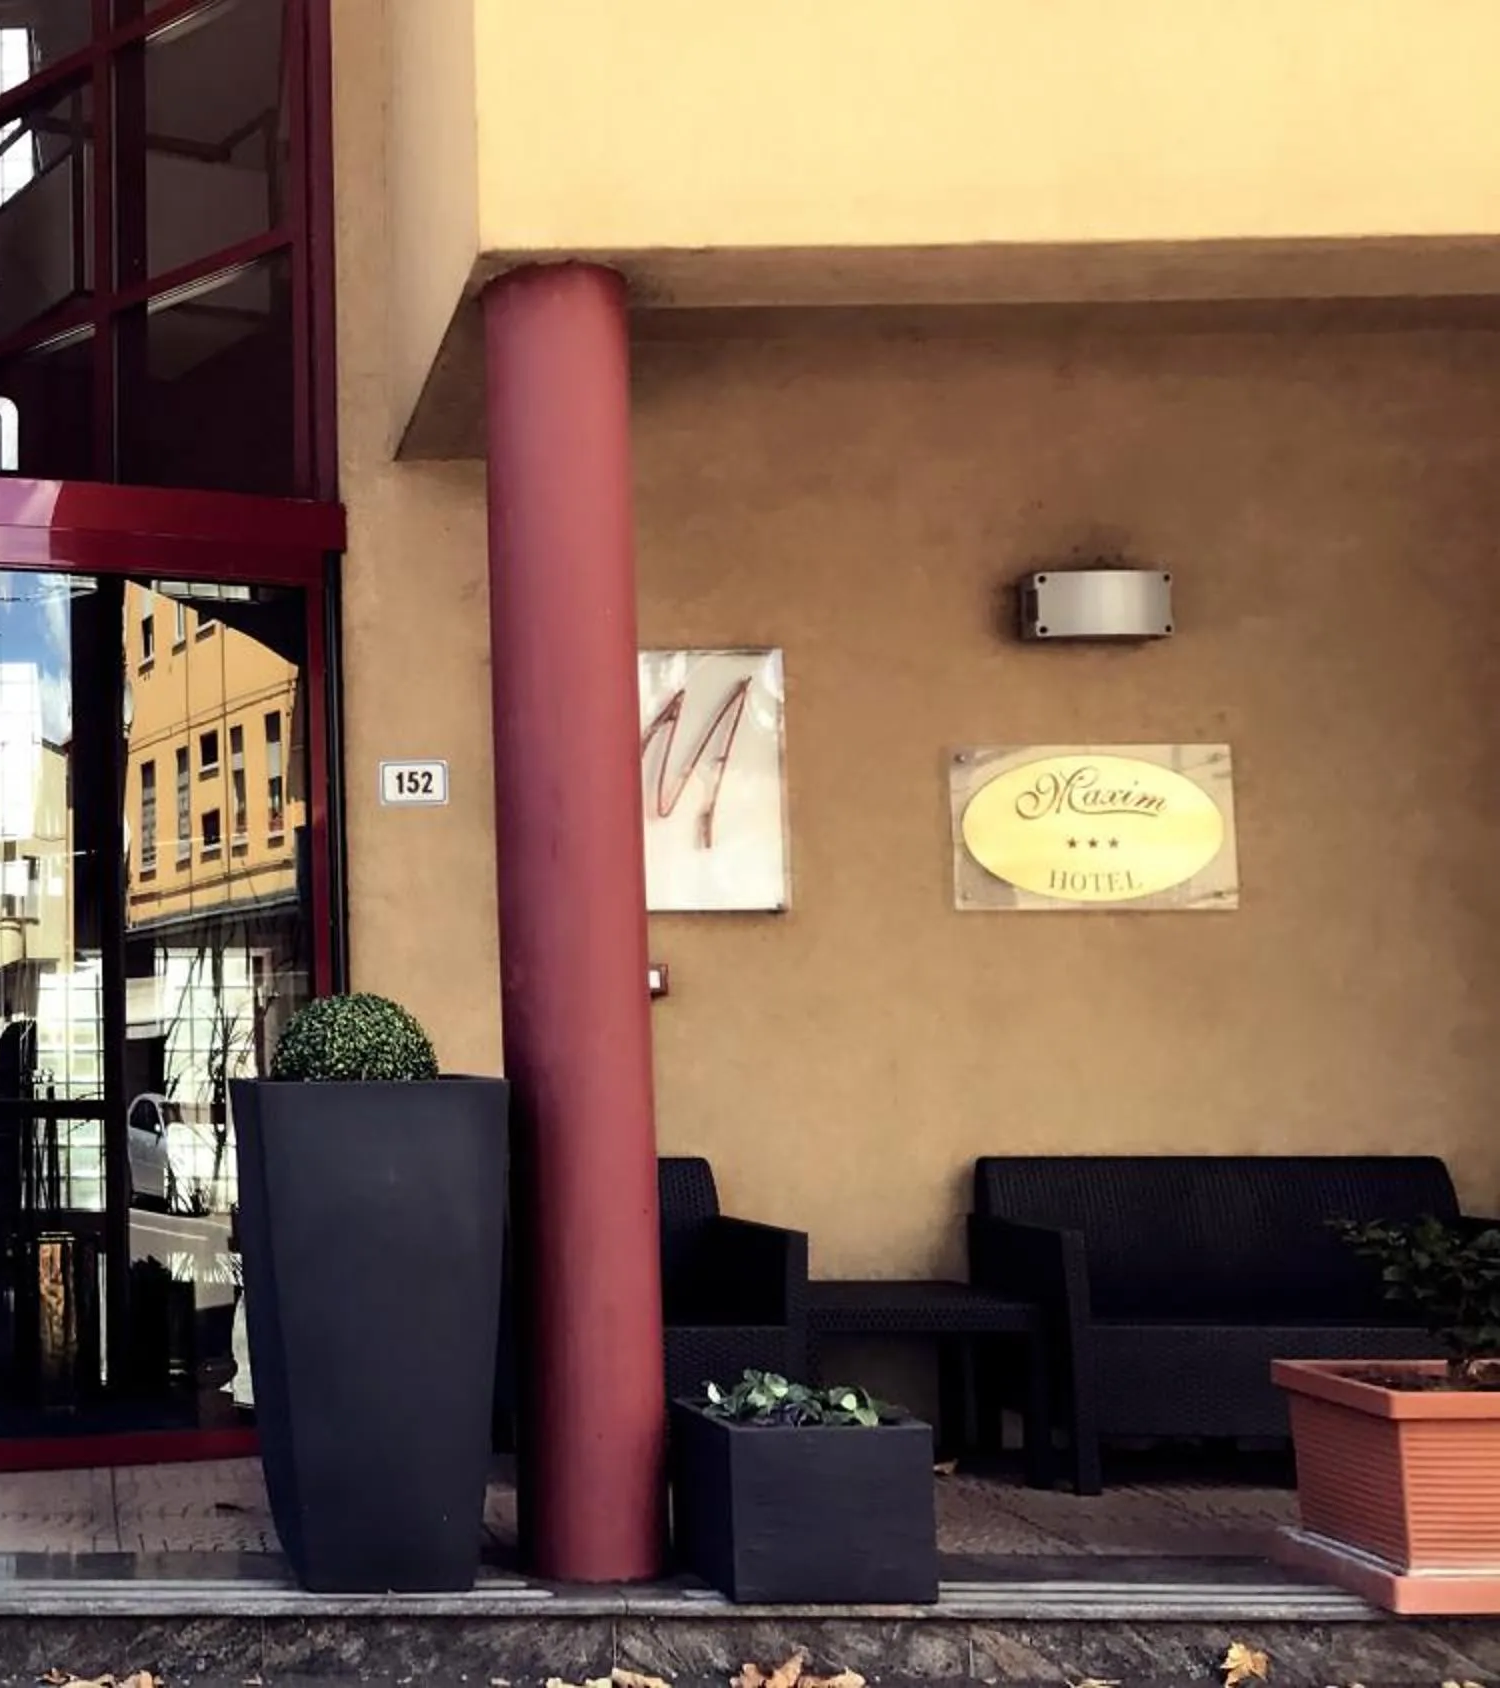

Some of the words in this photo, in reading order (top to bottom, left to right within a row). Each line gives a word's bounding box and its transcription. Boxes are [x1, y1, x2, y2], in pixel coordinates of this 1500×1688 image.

[395, 770, 434, 795] 152
[1015, 766, 1167, 820] Maxim
[1049, 869, 1142, 893] HOTEL
